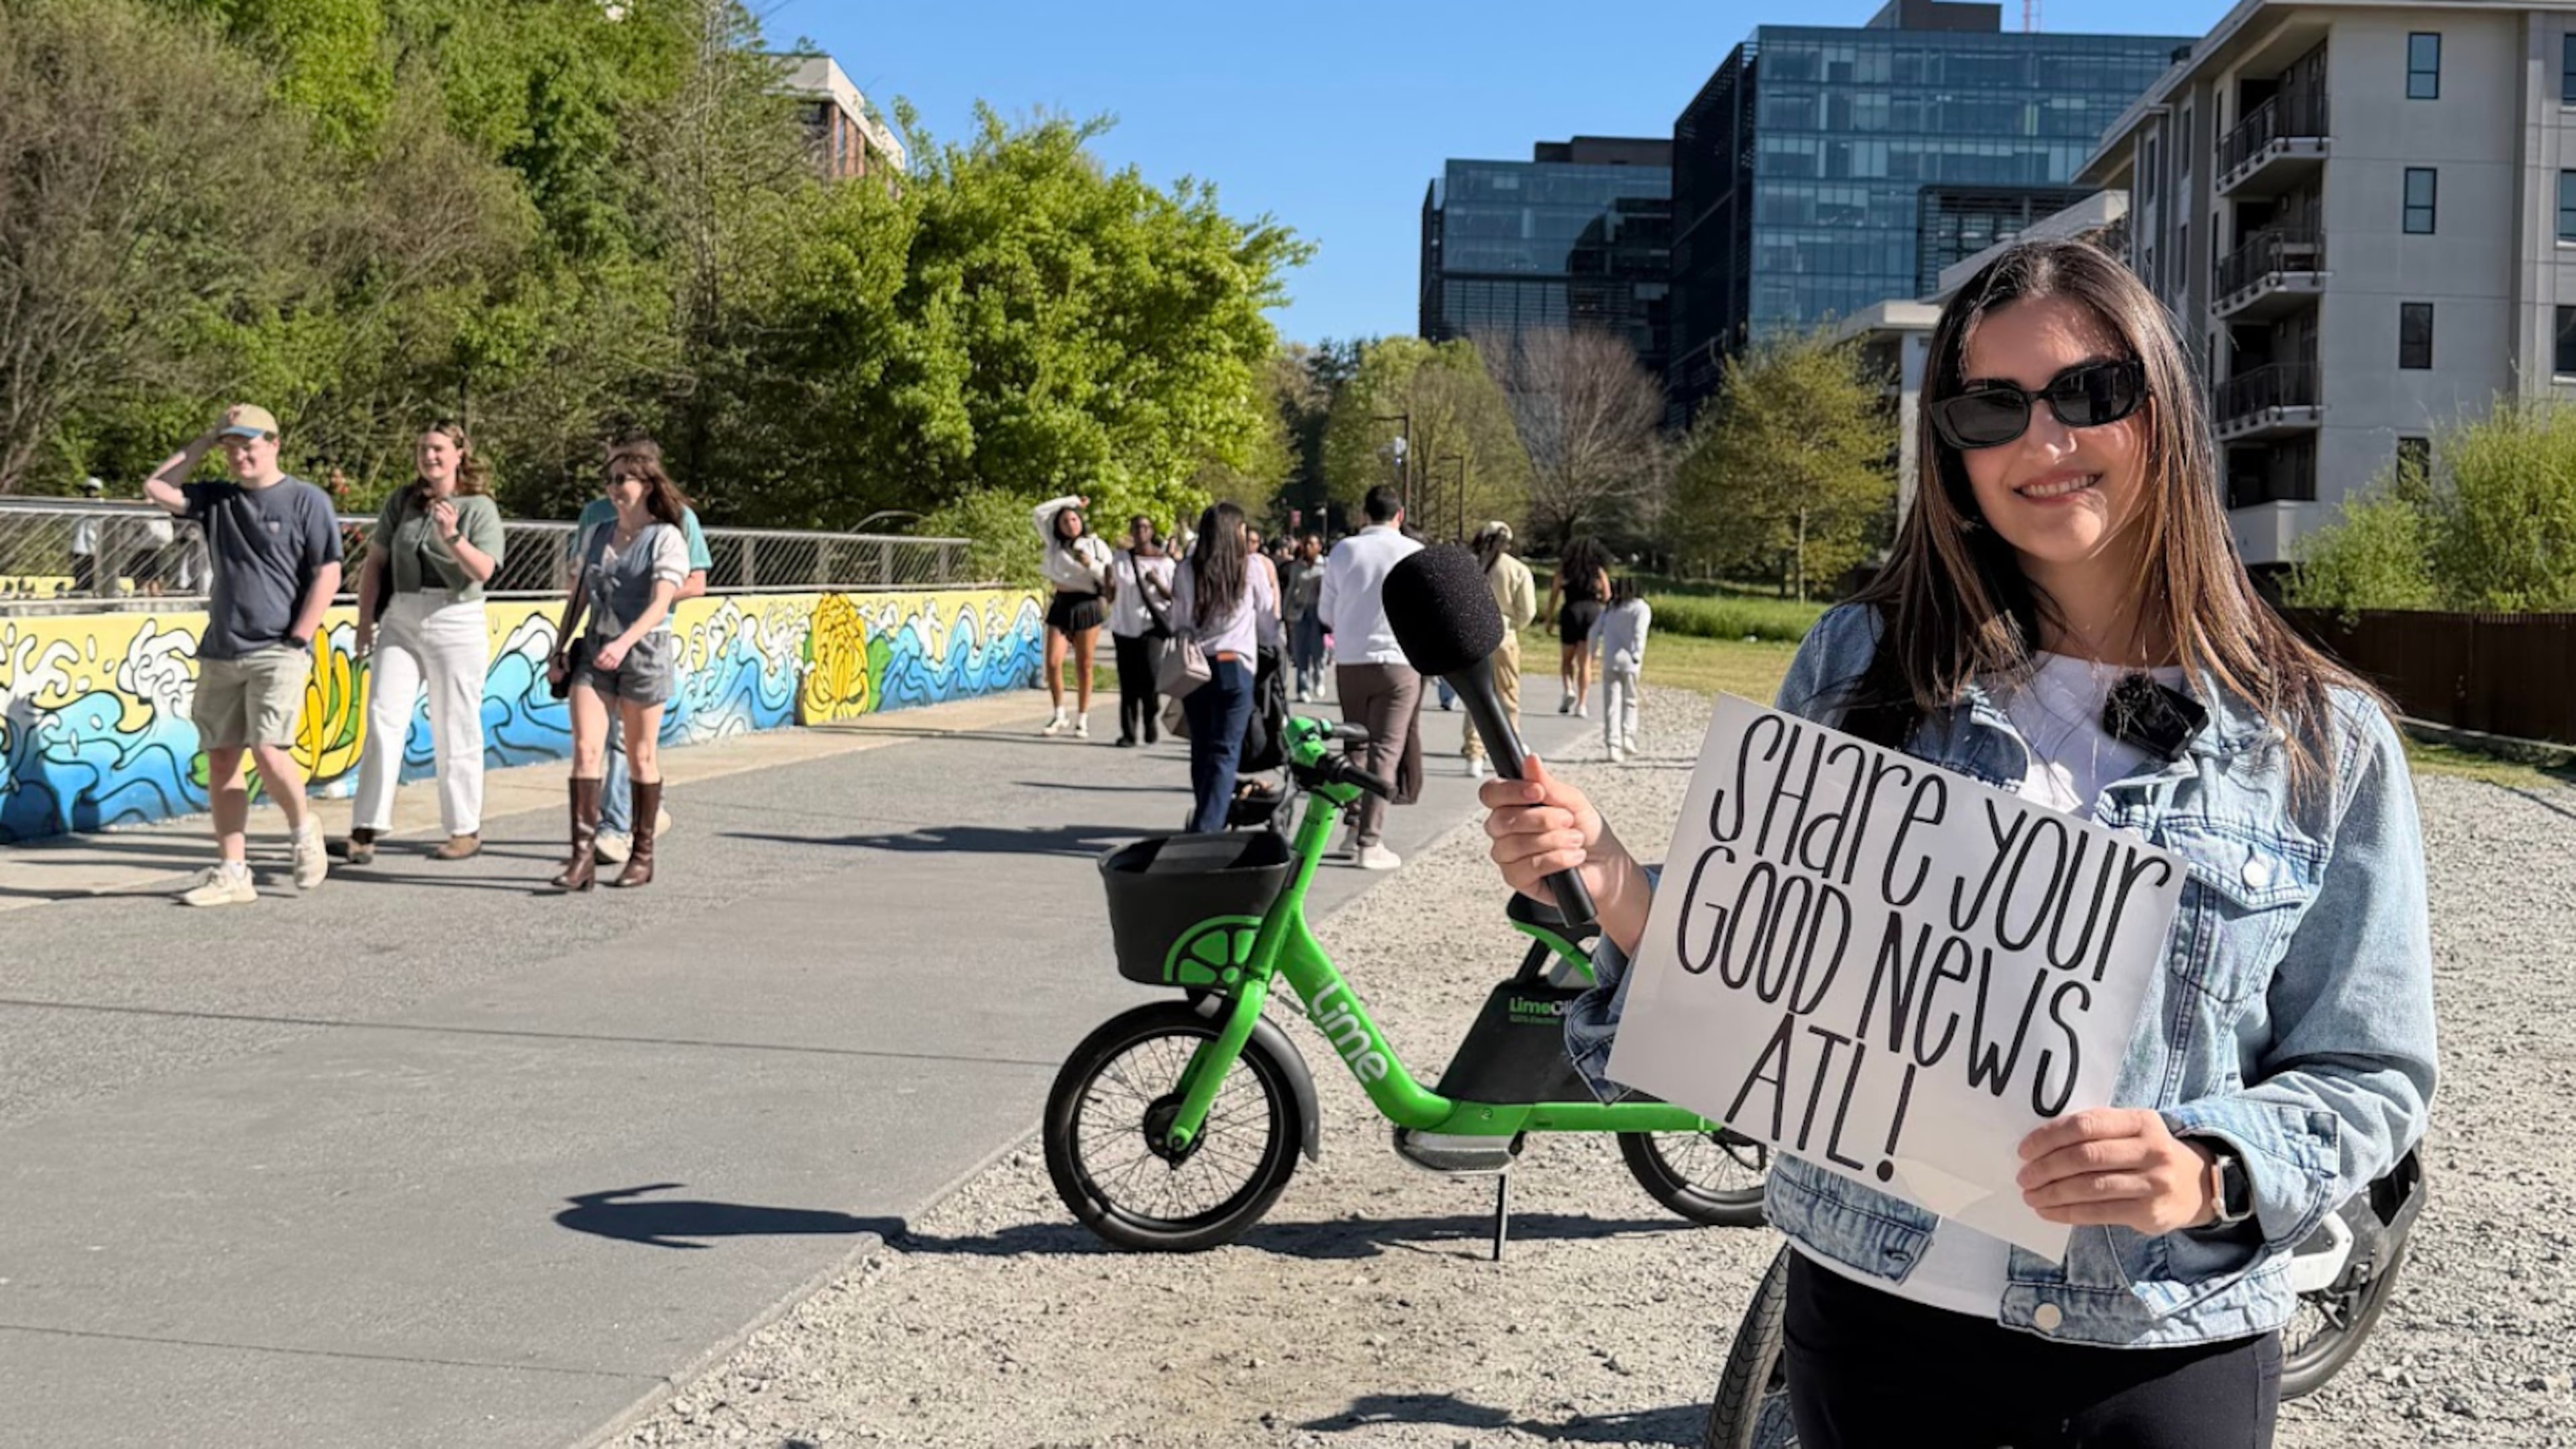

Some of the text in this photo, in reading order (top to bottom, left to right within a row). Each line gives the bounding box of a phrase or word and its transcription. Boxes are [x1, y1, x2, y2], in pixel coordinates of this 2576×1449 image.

[1678, 846, 1851, 1014] GOOD
[1312, 981, 1388, 1083] Lime
[1725, 1013, 1915, 1181] ATL!
